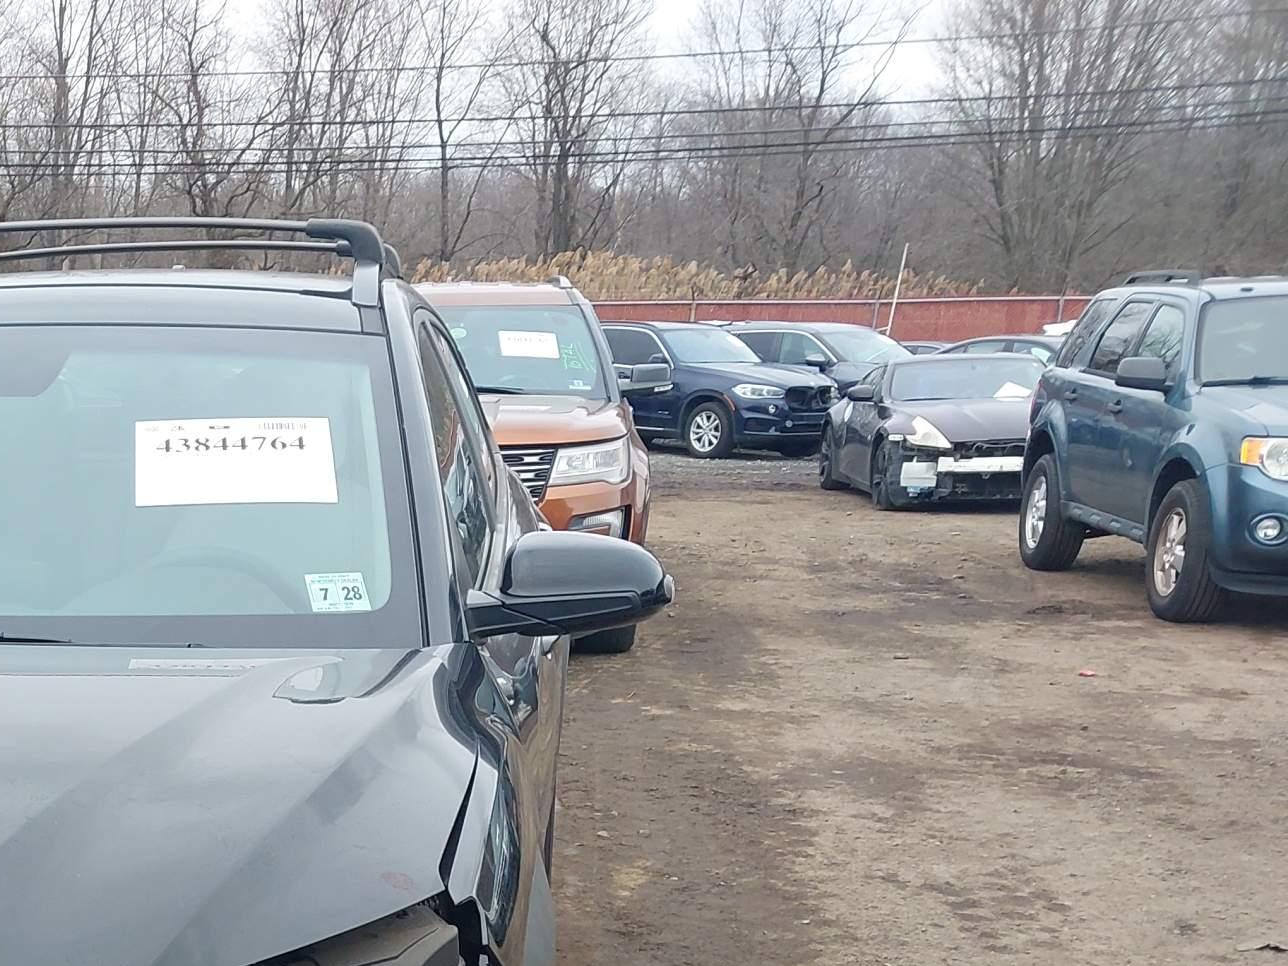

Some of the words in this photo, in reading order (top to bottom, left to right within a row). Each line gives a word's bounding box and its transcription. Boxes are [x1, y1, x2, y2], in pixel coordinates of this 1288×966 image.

[156, 436, 306, 453] 43844764
[319, 587, 329, 601] 7
[341, 585, 363, 601] 28
